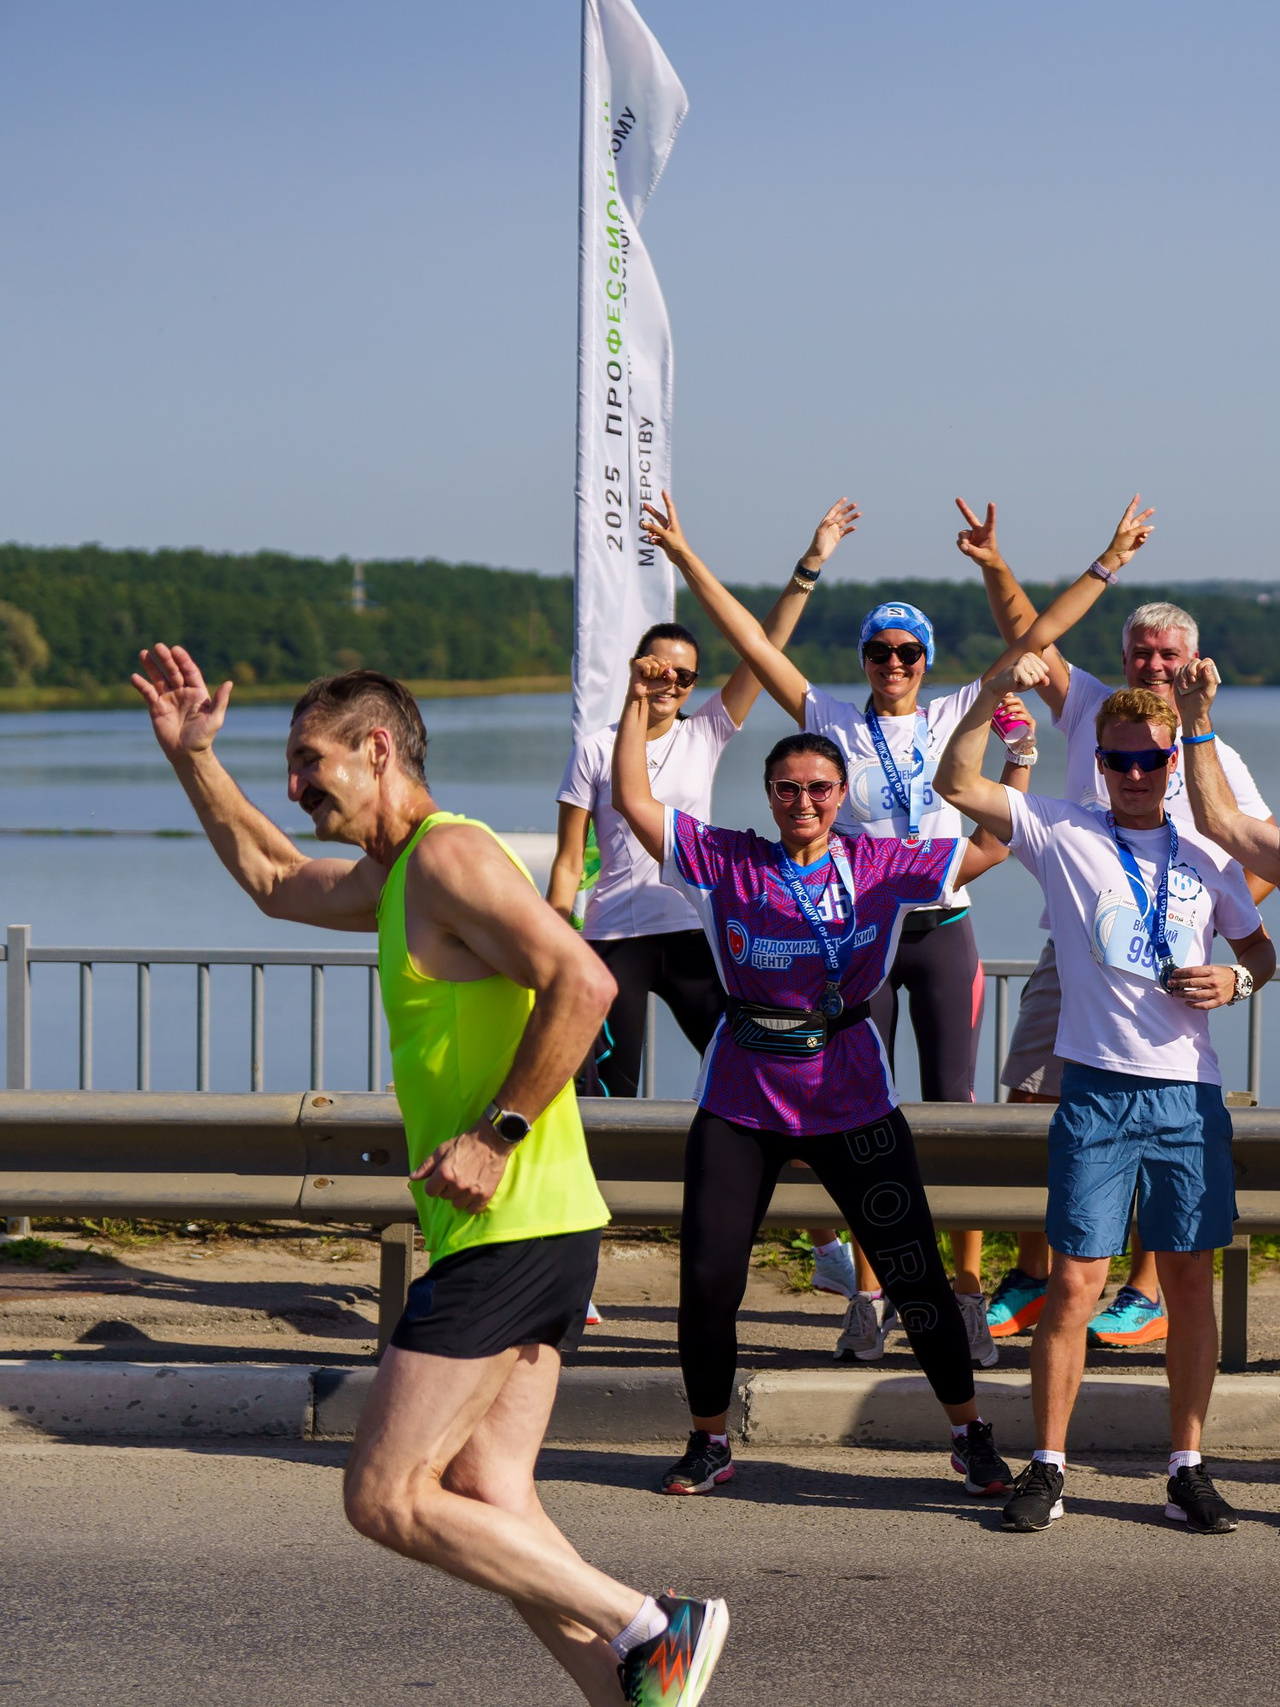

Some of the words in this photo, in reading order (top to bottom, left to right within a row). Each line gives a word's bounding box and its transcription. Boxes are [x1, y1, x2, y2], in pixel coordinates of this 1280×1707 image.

[604, 464, 623, 553] 2025
[880, 781, 934, 810] 35
[791, 879, 821, 927] КАЛУЖСКИЙ
[1133, 919, 1179, 944] ВИИЙ
[1158, 912, 1166, 944] СПОРТ
[752, 953, 792, 970] ЦЕНТР
[825, 938, 839, 969] СПОРТ
[844, 1118, 939, 1333] BORG
